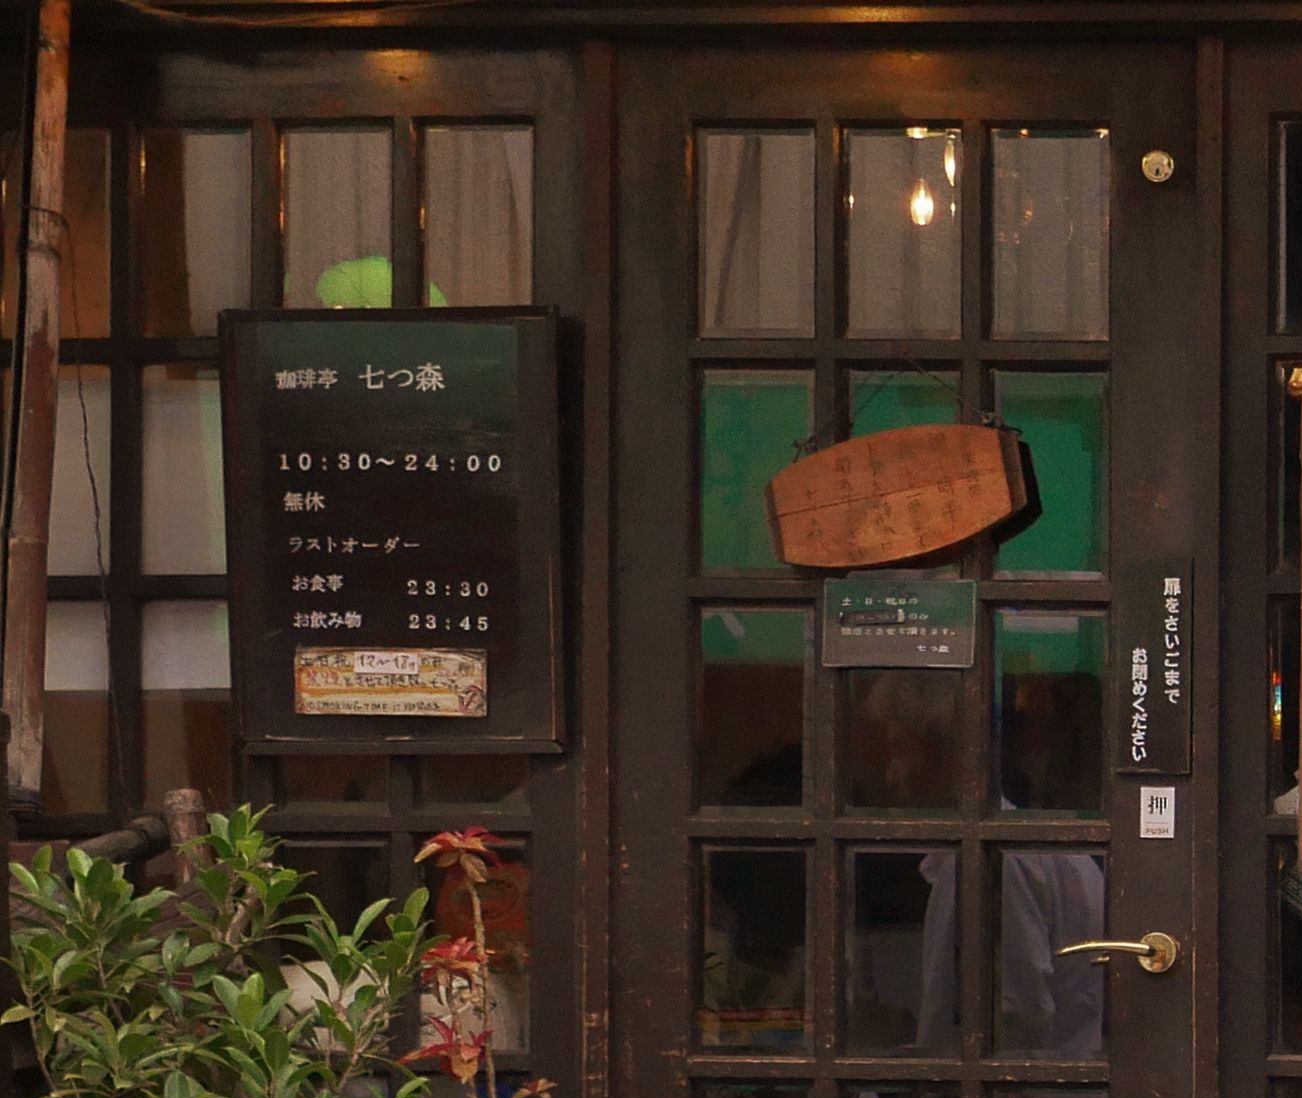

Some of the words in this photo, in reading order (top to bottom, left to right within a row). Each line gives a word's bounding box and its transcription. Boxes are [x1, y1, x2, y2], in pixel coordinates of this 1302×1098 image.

[359, 362, 446, 392] 七つ森
[283, 491, 327, 512] 無休
[288, 536, 420, 554] ラストオーダー
[292, 574, 344, 592] お食事
[407, 579, 489, 597] 23:30
[293, 611, 362, 629] お飲み物
[408, 614, 489, 631] 23:45
[1147, 795, 1168, 815] 押
